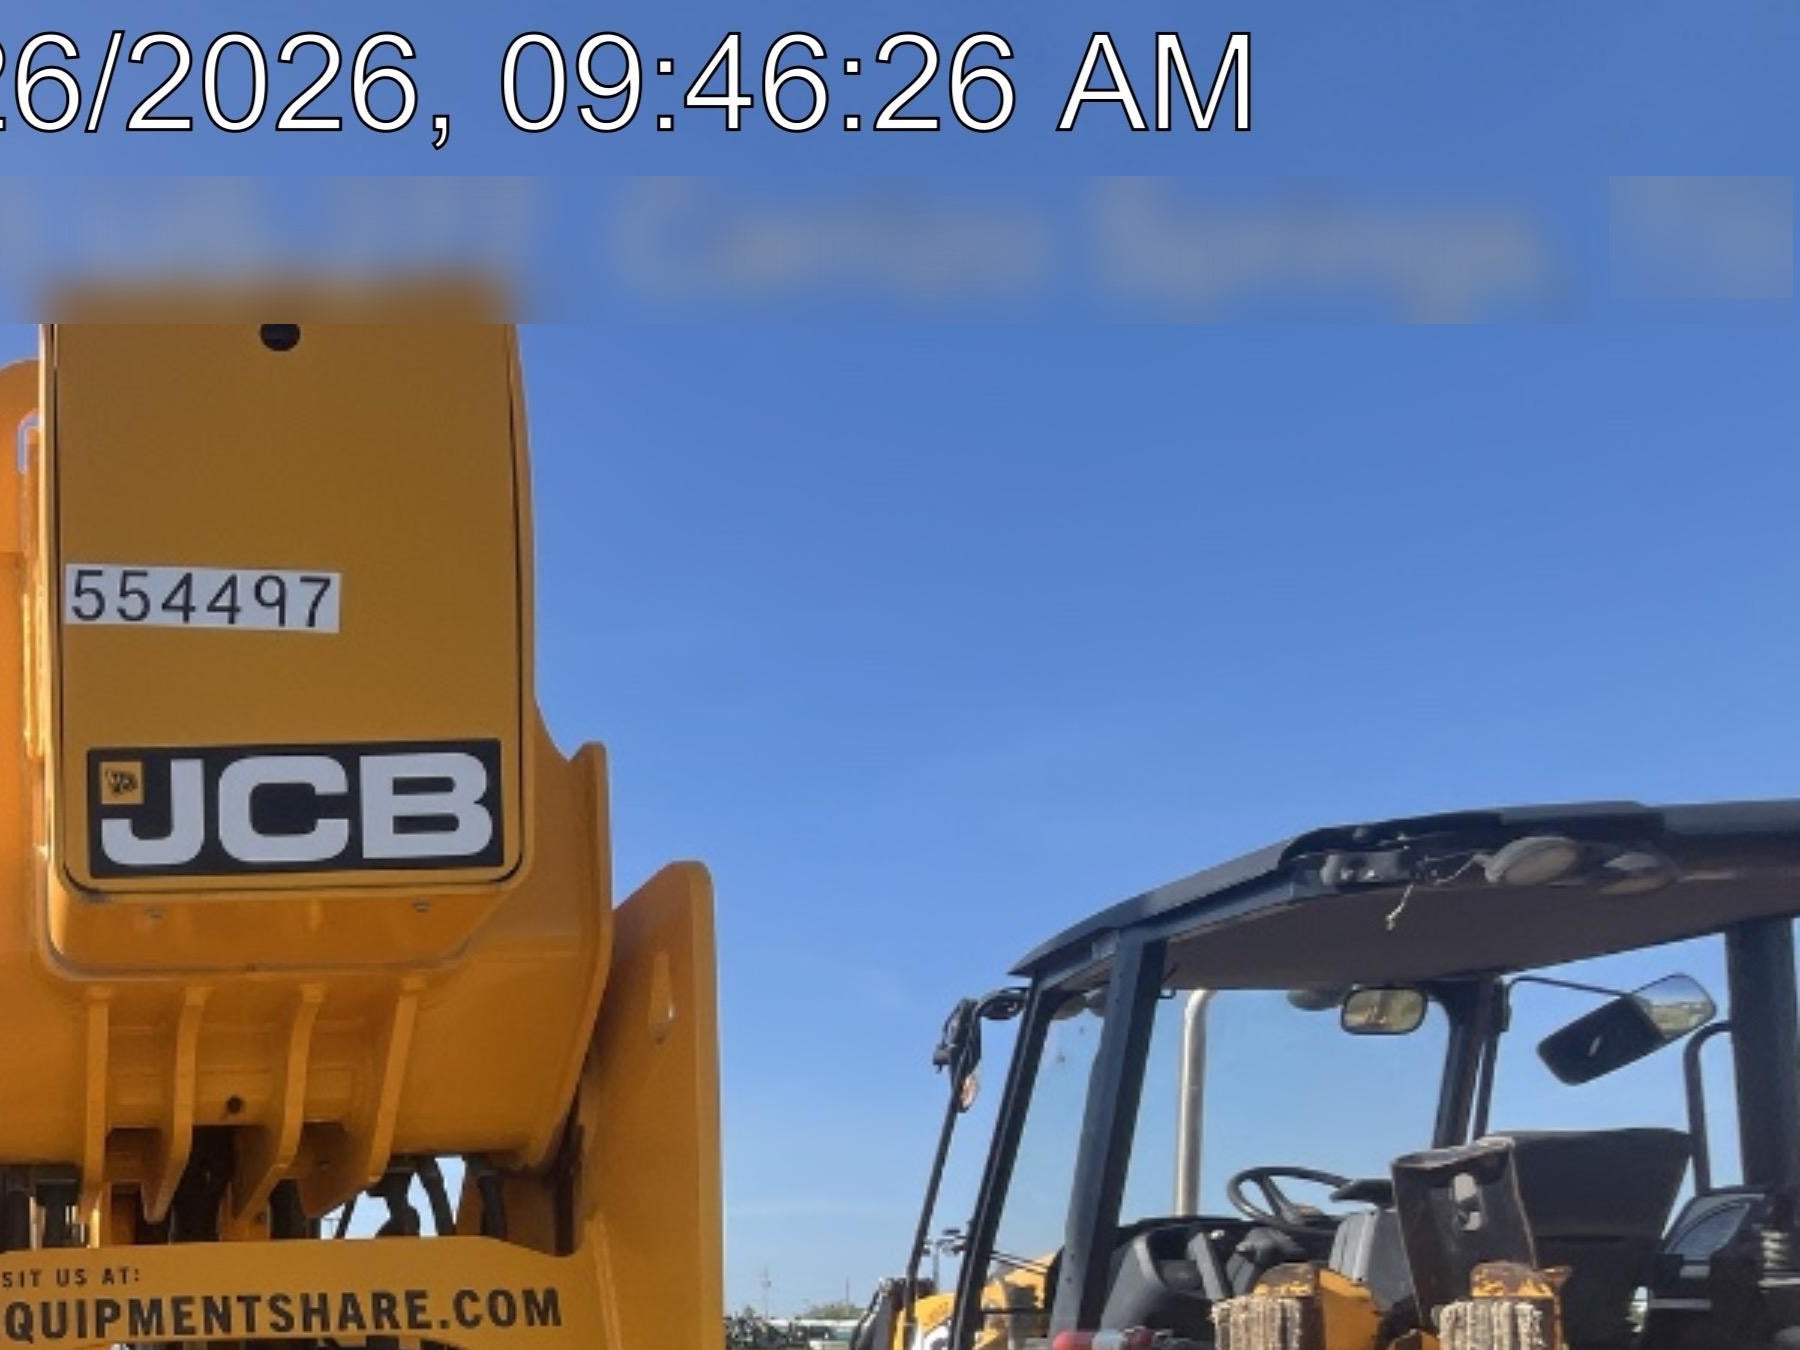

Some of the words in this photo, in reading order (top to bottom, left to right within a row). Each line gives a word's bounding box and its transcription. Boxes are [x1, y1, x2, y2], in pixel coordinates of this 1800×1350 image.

[72, 569, 332, 628] 554497
[101, 752, 493, 866] JCB
[56, 1268, 87, 1285] US
[102, 1266, 140, 1285] AT:
